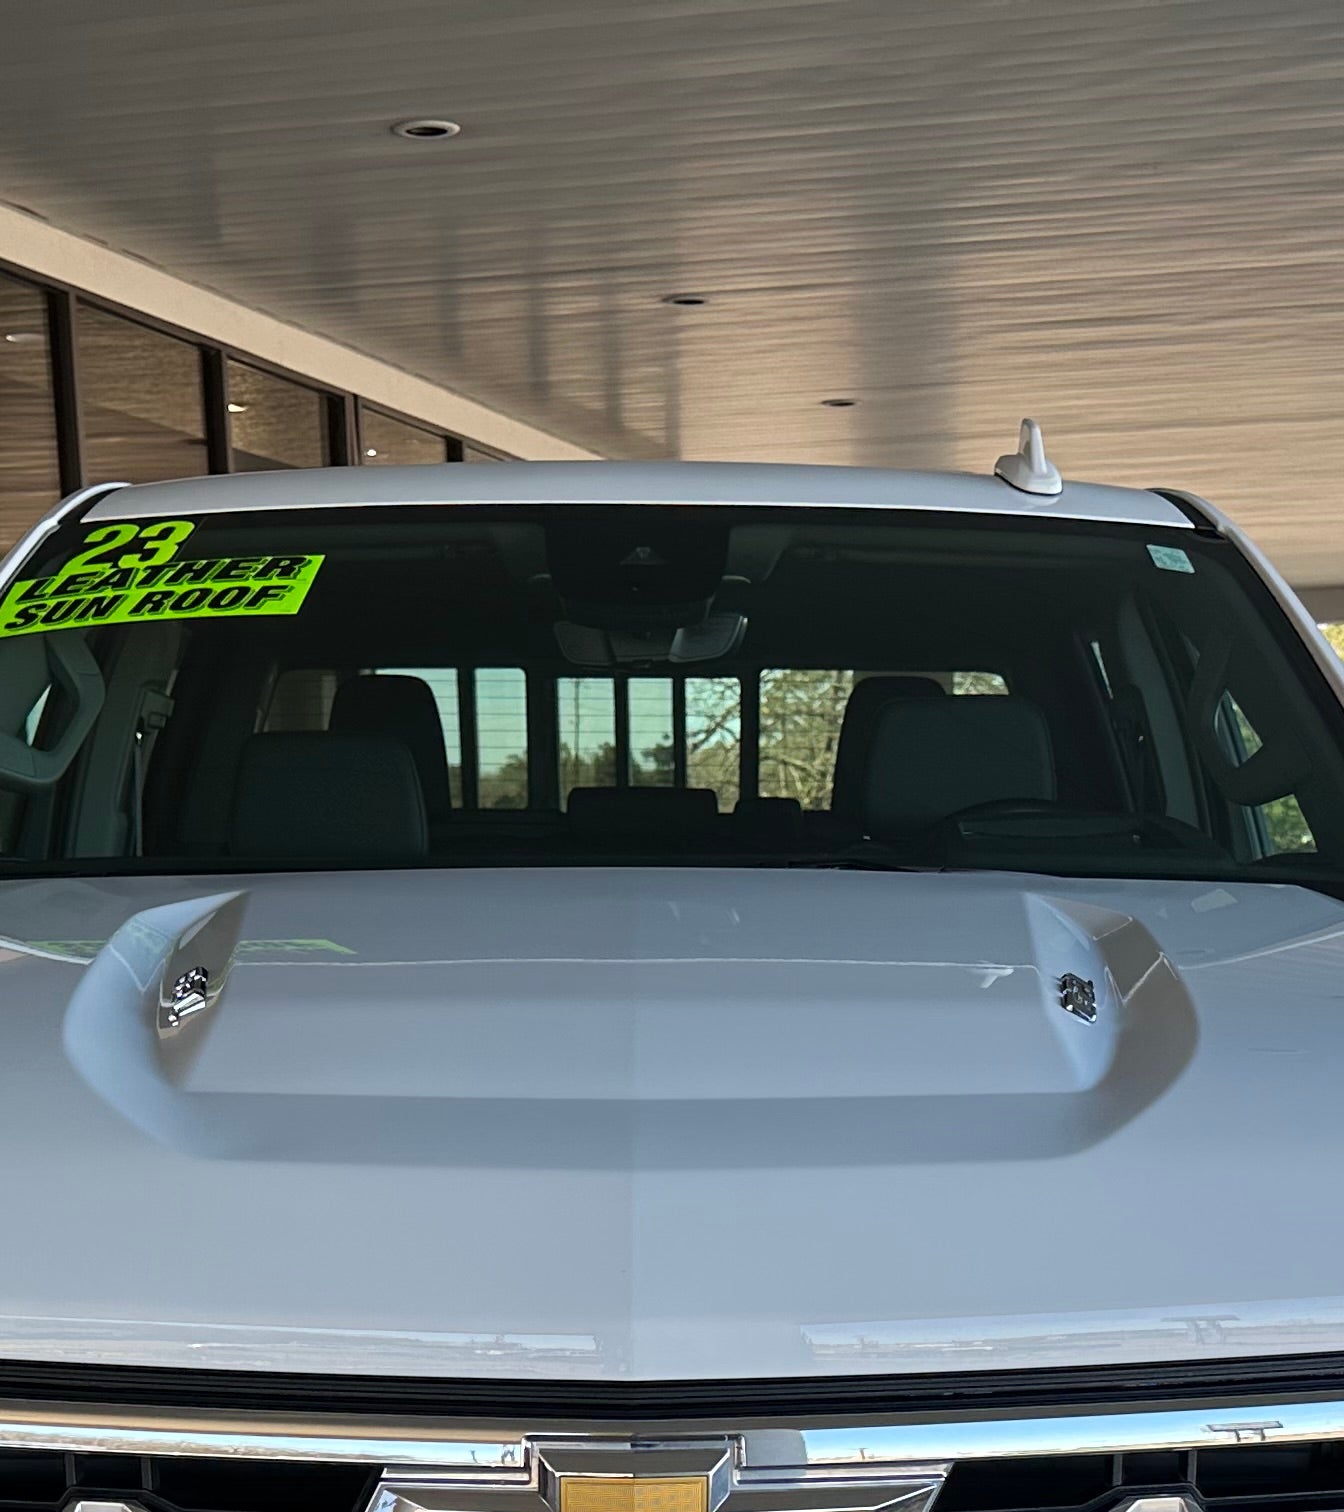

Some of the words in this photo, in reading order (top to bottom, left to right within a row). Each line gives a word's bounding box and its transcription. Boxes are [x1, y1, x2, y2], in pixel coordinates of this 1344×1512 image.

[58, 521, 195, 575] 23
[15, 556, 312, 603] LEATHER
[4, 594, 127, 631] SUN
[128, 585, 295, 617] ROOF
